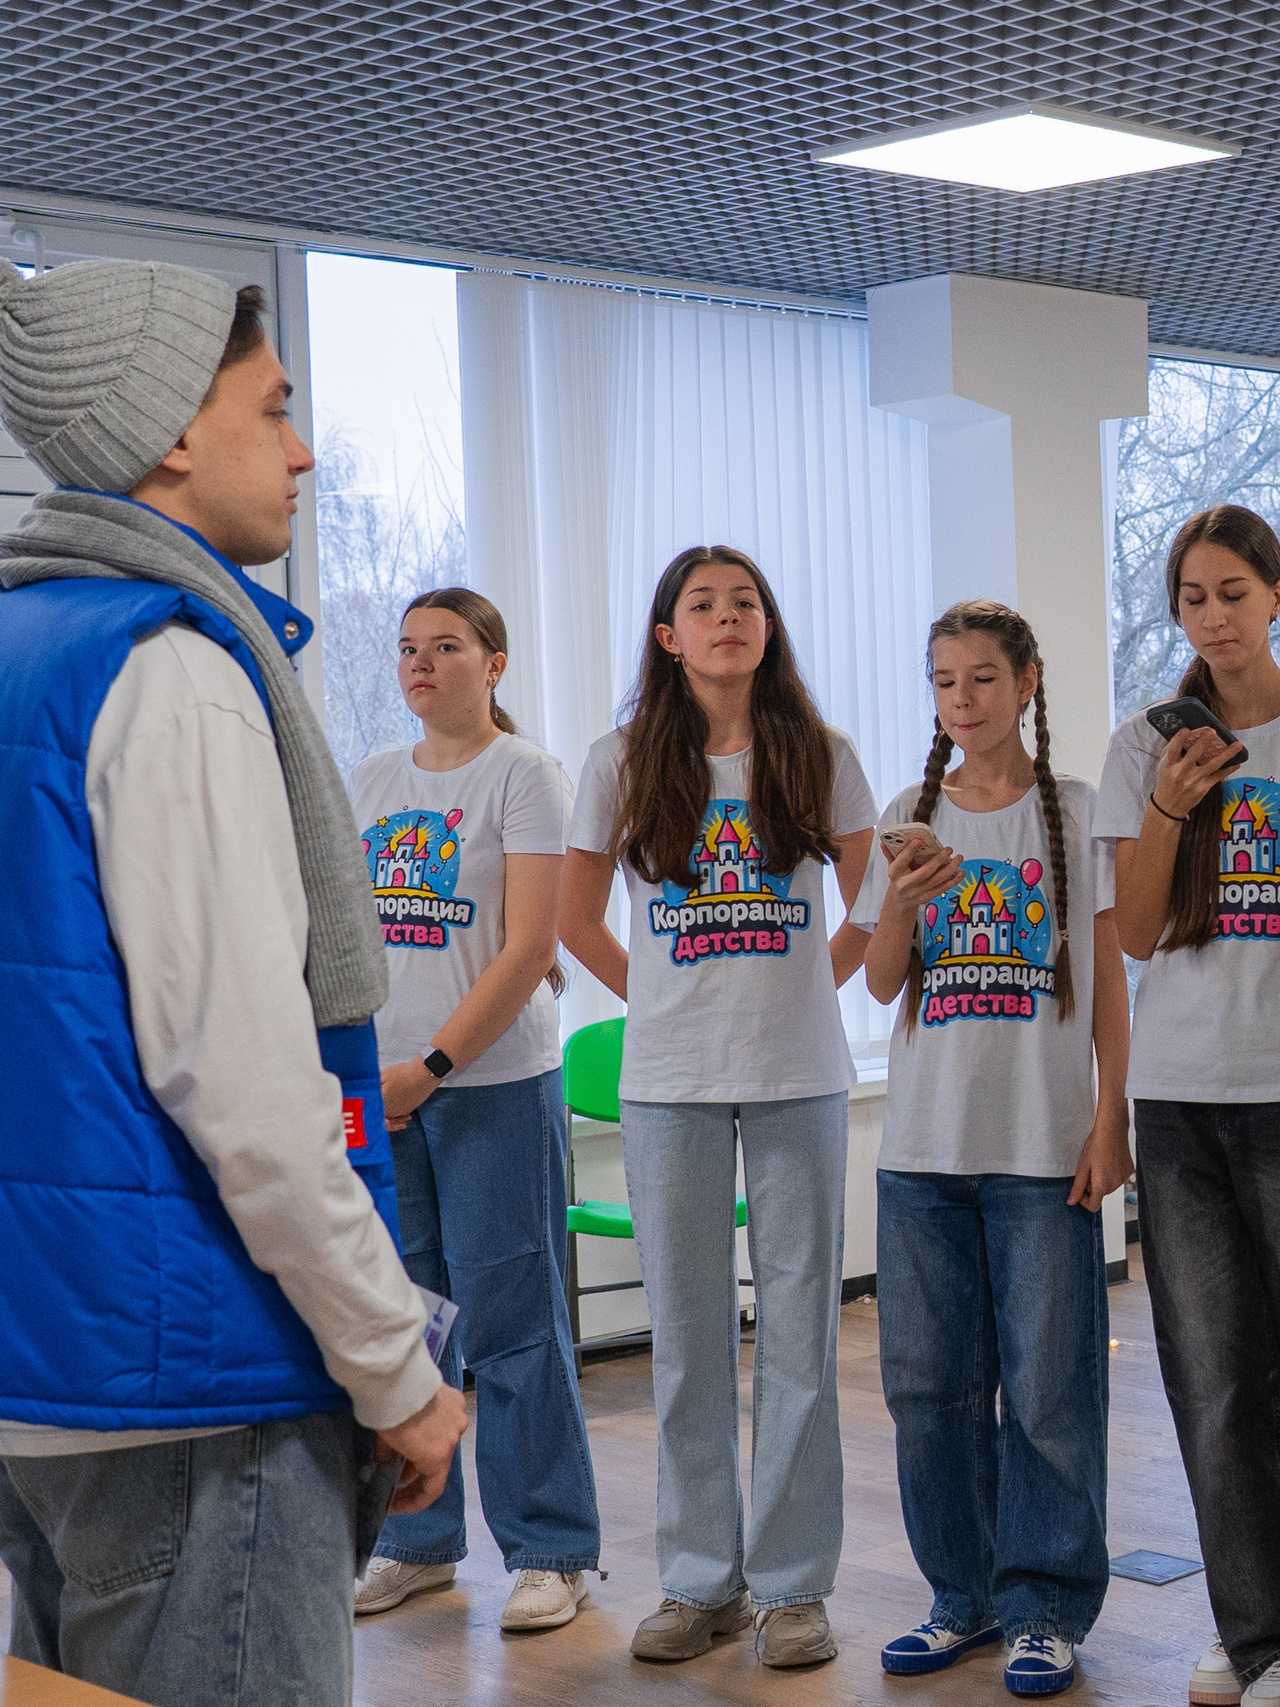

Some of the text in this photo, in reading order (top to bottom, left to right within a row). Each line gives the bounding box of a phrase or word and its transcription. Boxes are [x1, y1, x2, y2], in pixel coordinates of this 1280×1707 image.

[374, 897, 470, 923] порация
[651, 902, 806, 933] Корпорация
[381, 923, 443, 945] тства
[675, 930, 786, 961] детства
[922, 965, 1055, 993] орпорация
[926, 994, 1032, 1022] детства
